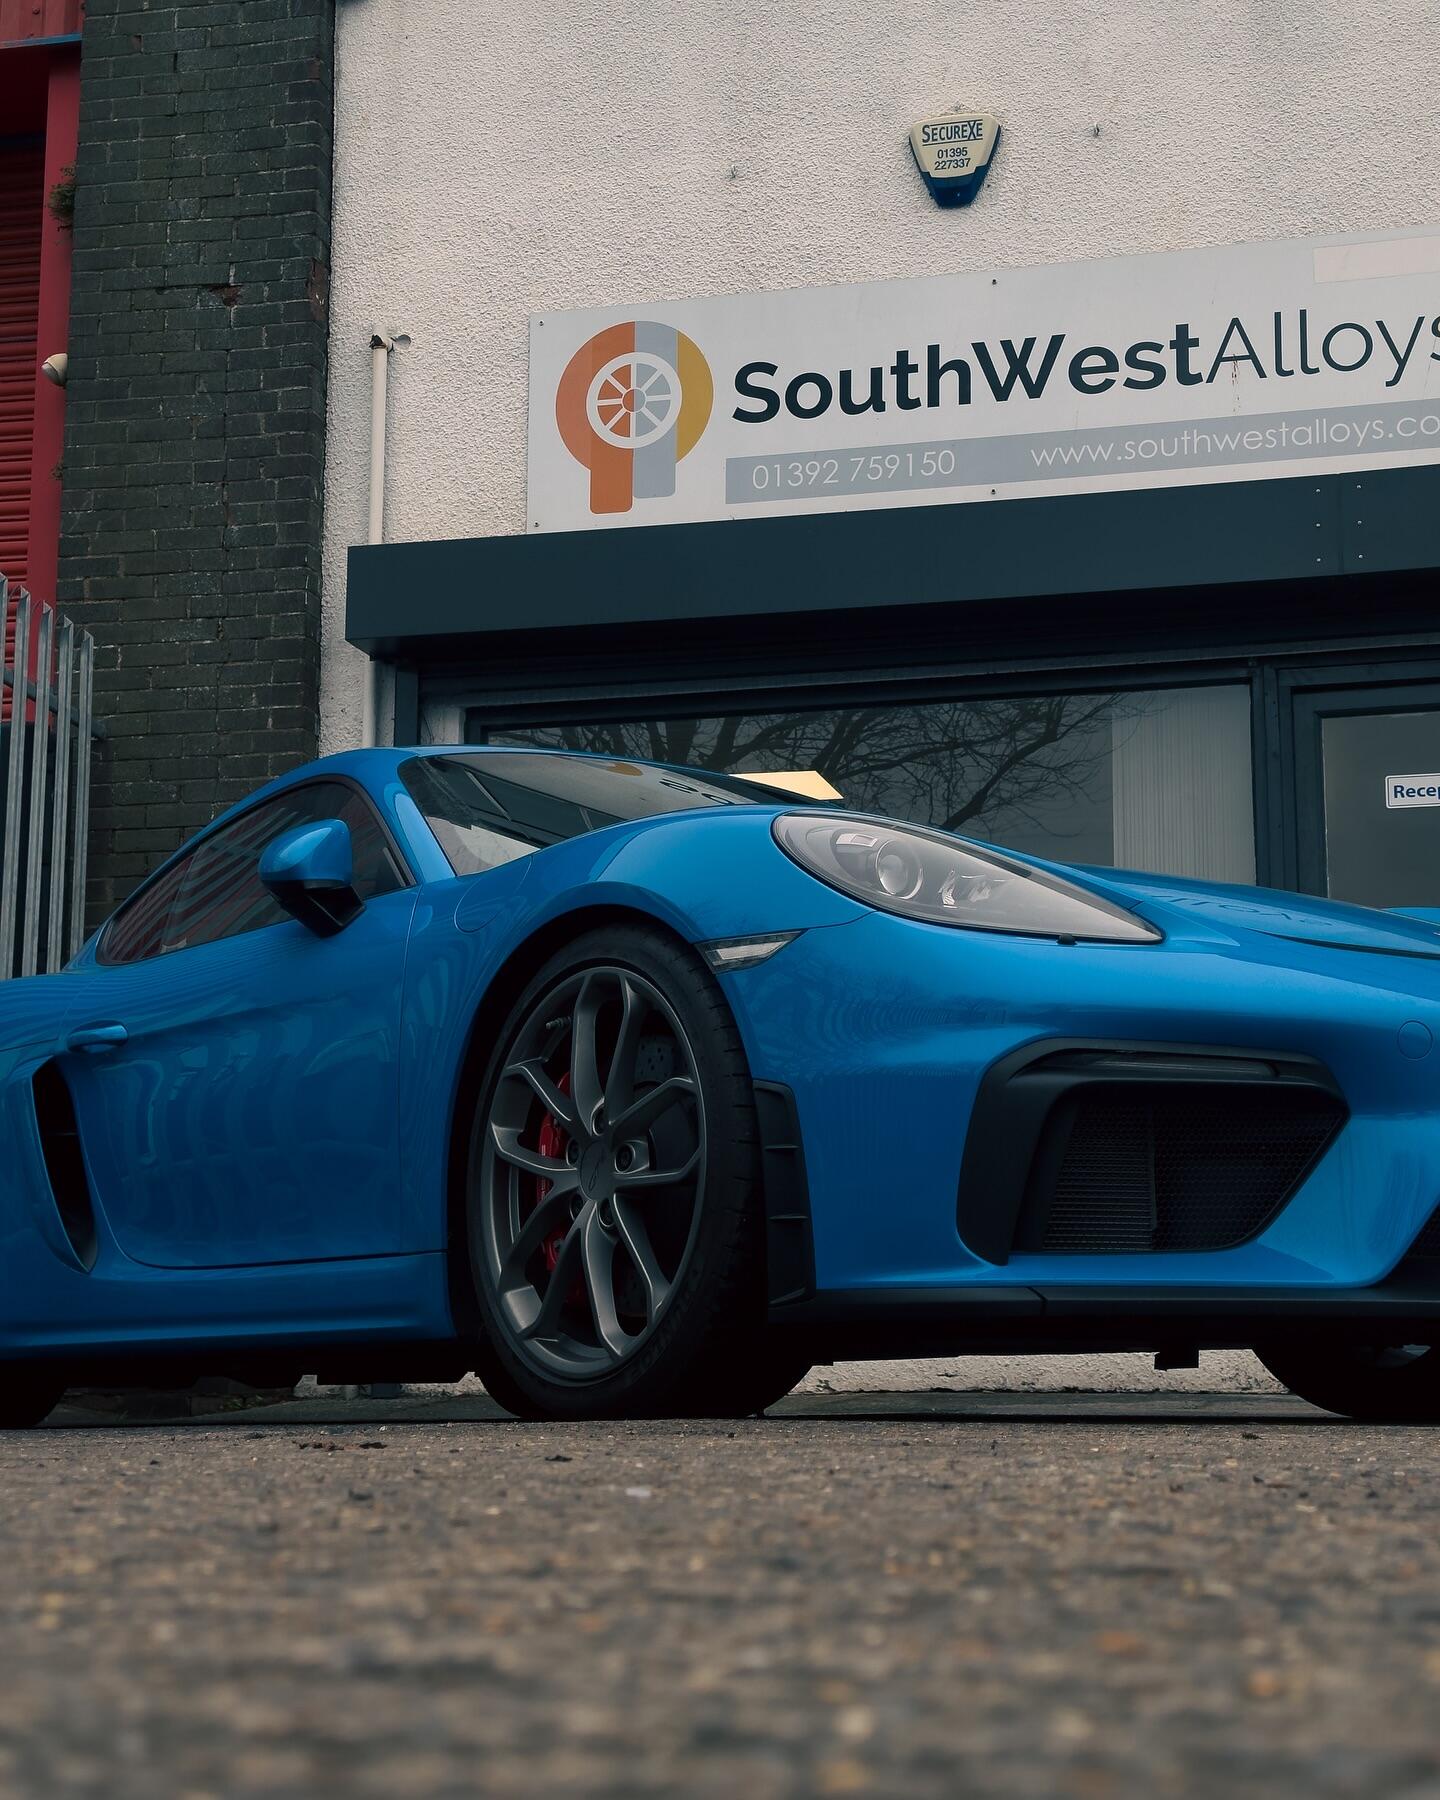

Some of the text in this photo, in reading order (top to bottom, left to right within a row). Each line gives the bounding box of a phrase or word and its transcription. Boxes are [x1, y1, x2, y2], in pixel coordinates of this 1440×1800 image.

[937, 147, 968, 159] 01395
[934, 158, 971, 171] 227337
[1031, 415, 1440, 468] www.southwestalloys.co
[752, 450, 955, 490] 01392 759150
[1393, 785, 1440, 800] Rece
